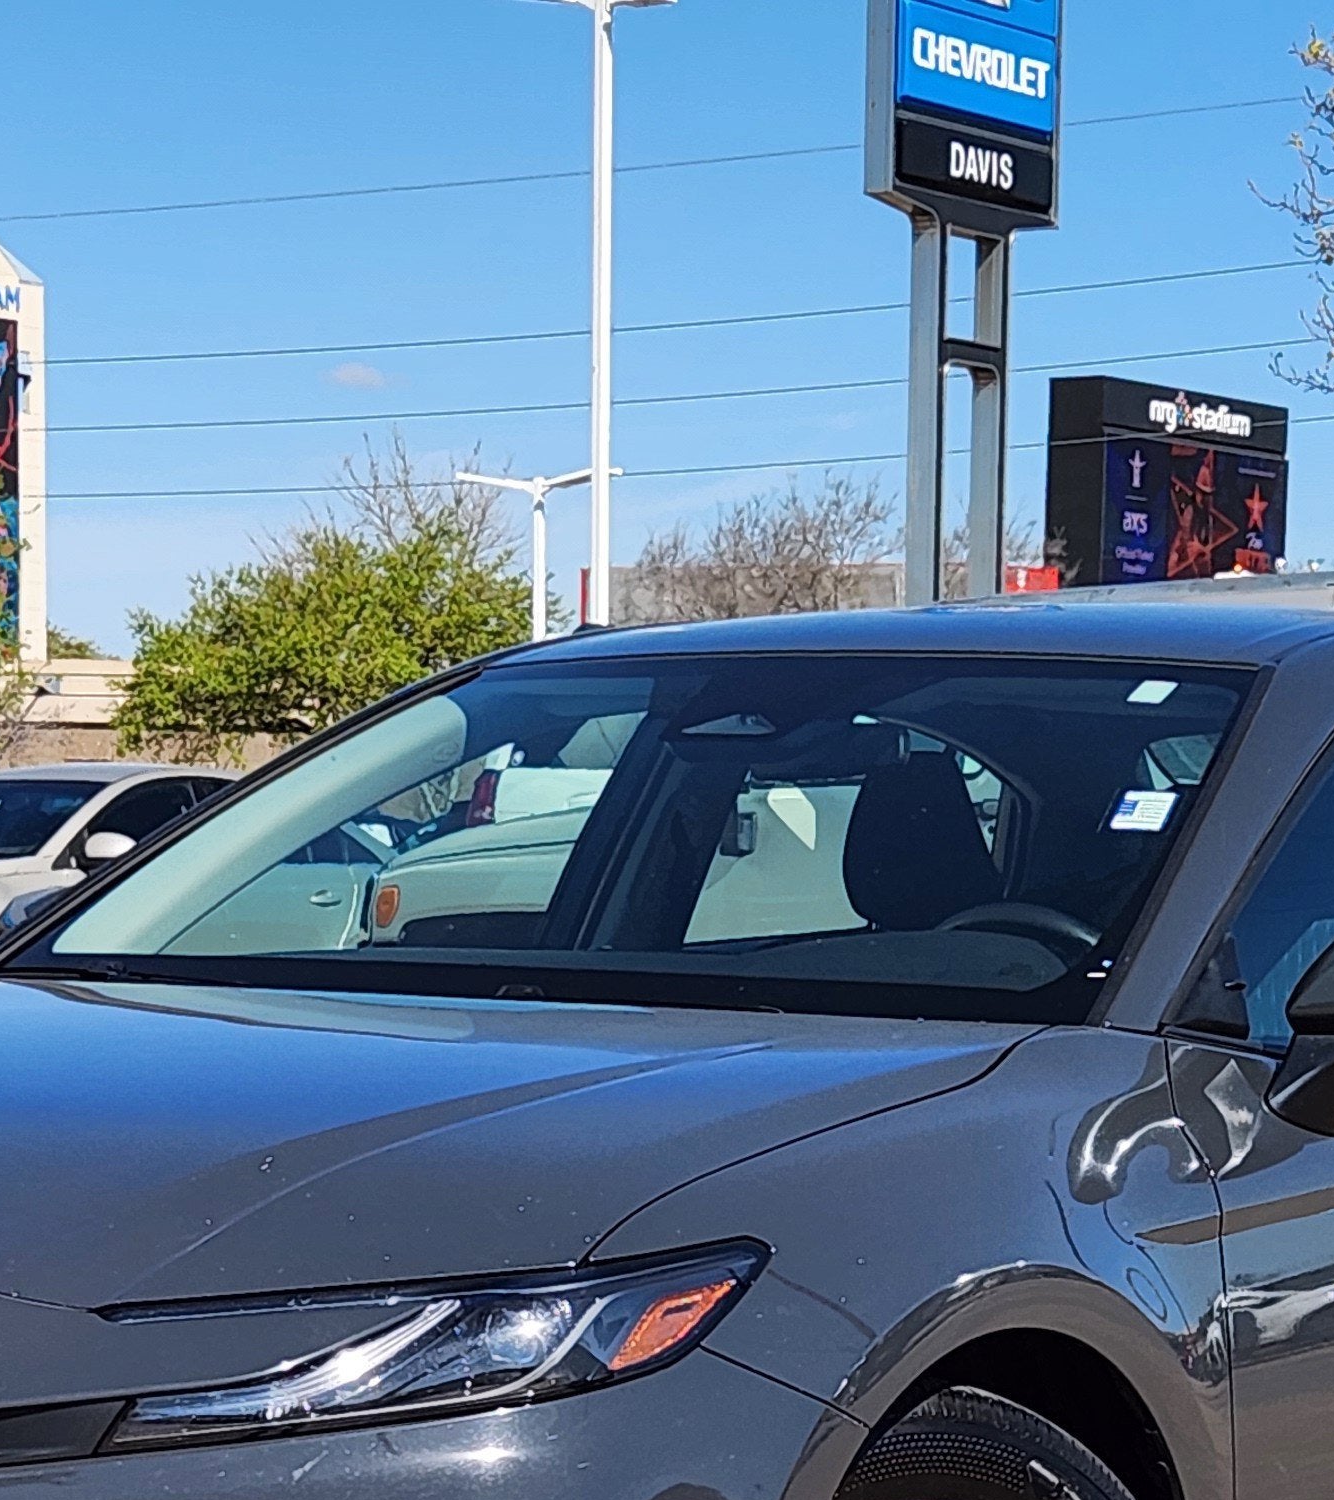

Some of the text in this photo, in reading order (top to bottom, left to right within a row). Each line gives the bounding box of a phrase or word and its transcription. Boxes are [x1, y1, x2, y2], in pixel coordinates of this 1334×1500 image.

[912, 27, 1050, 98] CHEVROLET
[949, 141, 1013, 190] DAVIS
[1149, 399, 1251, 437] nrg stadium
